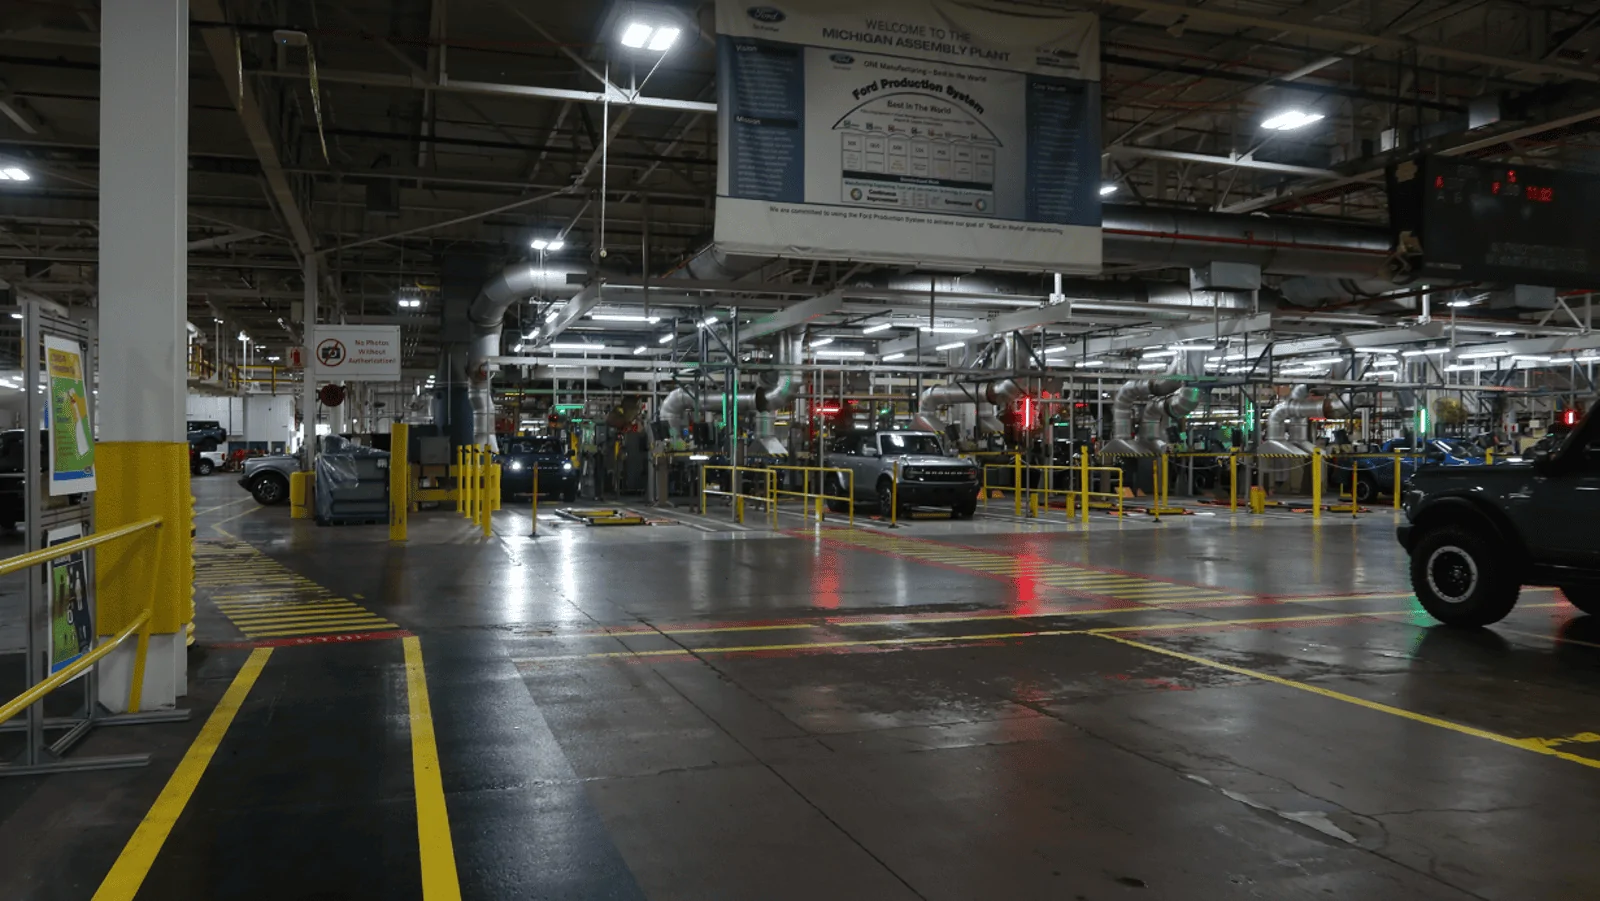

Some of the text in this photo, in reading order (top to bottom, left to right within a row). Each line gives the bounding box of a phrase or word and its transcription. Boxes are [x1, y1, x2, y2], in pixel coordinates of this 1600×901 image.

[865, 18, 971, 42] WELCOME TO THE
[735, 44, 758, 52] Vision
[822, 27, 1010, 62] MICHIGAN ASSEMBLY PLANT
[864, 60, 878, 69] ONE
[880, 63, 927, 76] Manufacturing
[853, 77, 985, 114] Ford Production System
[887, 99, 905, 110] Best
[930, 105, 952, 114] World
[736, 115, 761, 126] Mission
[769, 205, 779, 213] We
[791, 207, 822, 215] committed
[873, 214, 904, 223] Production
